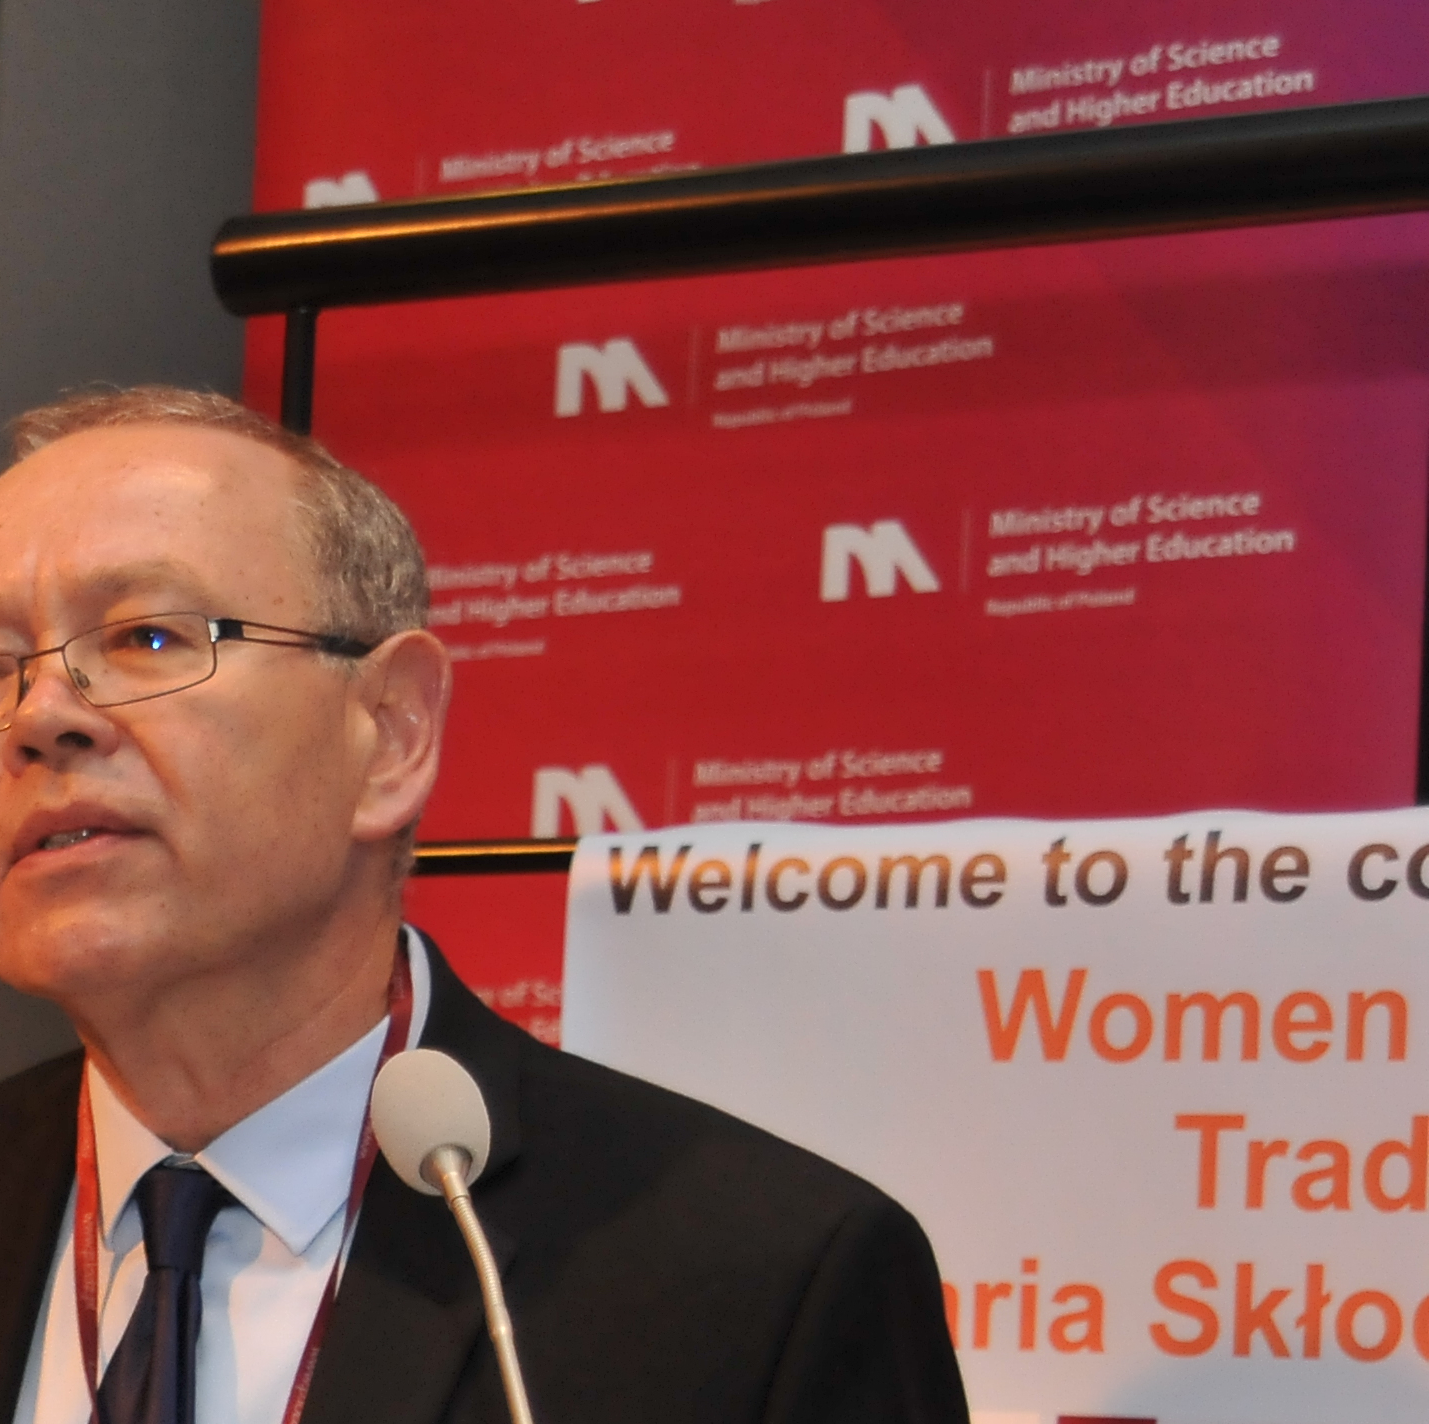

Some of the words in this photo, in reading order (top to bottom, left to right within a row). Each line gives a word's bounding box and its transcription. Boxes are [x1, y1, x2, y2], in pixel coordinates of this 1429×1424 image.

[1009, 59, 1123, 95] Ministry
[1129, 45, 1162, 76] of
[1166, 35, 1281, 71] Science
[1007, 101, 1060, 133] and
[1065, 91, 1160, 127] Higher
[1165, 70, 1315, 110] Education
[440, 147, 540, 182] Ministry
[543, 138, 573, 169] of
[577, 129, 676, 164] Science
[716, 321, 823, 354] Ministry
[828, 310, 859, 340] of
[862, 303, 964, 336] Science
[714, 360, 765, 391] and
[768, 353, 857, 388] Higher
[859, 335, 993, 374] Education
[988, 505, 1104, 538] Ministry
[1109, 494, 1143, 527] of
[1145, 492, 1262, 524] Science
[521, 553, 552, 583] of
[554, 550, 654, 581] Science
[986, 543, 1041, 577] and
[1044, 539, 1141, 576] Higher
[1145, 527, 1296, 563] Education
[464, 595, 549, 628] Higher
[552, 583, 682, 617] Education
[694, 759, 802, 788] Ministry
[805, 750, 837, 781] of
[841, 748, 943, 779] Science
[839, 783, 973, 816] Education
[608, 843, 1008, 915] Welcome
[1042, 836, 1130, 908] to
[1163, 830, 1310, 905] the
[976, 967, 1410, 1064] Women
[1174, 1112, 1429, 1213] Trad
[1148, 1258, 1429, 1363] Skło
